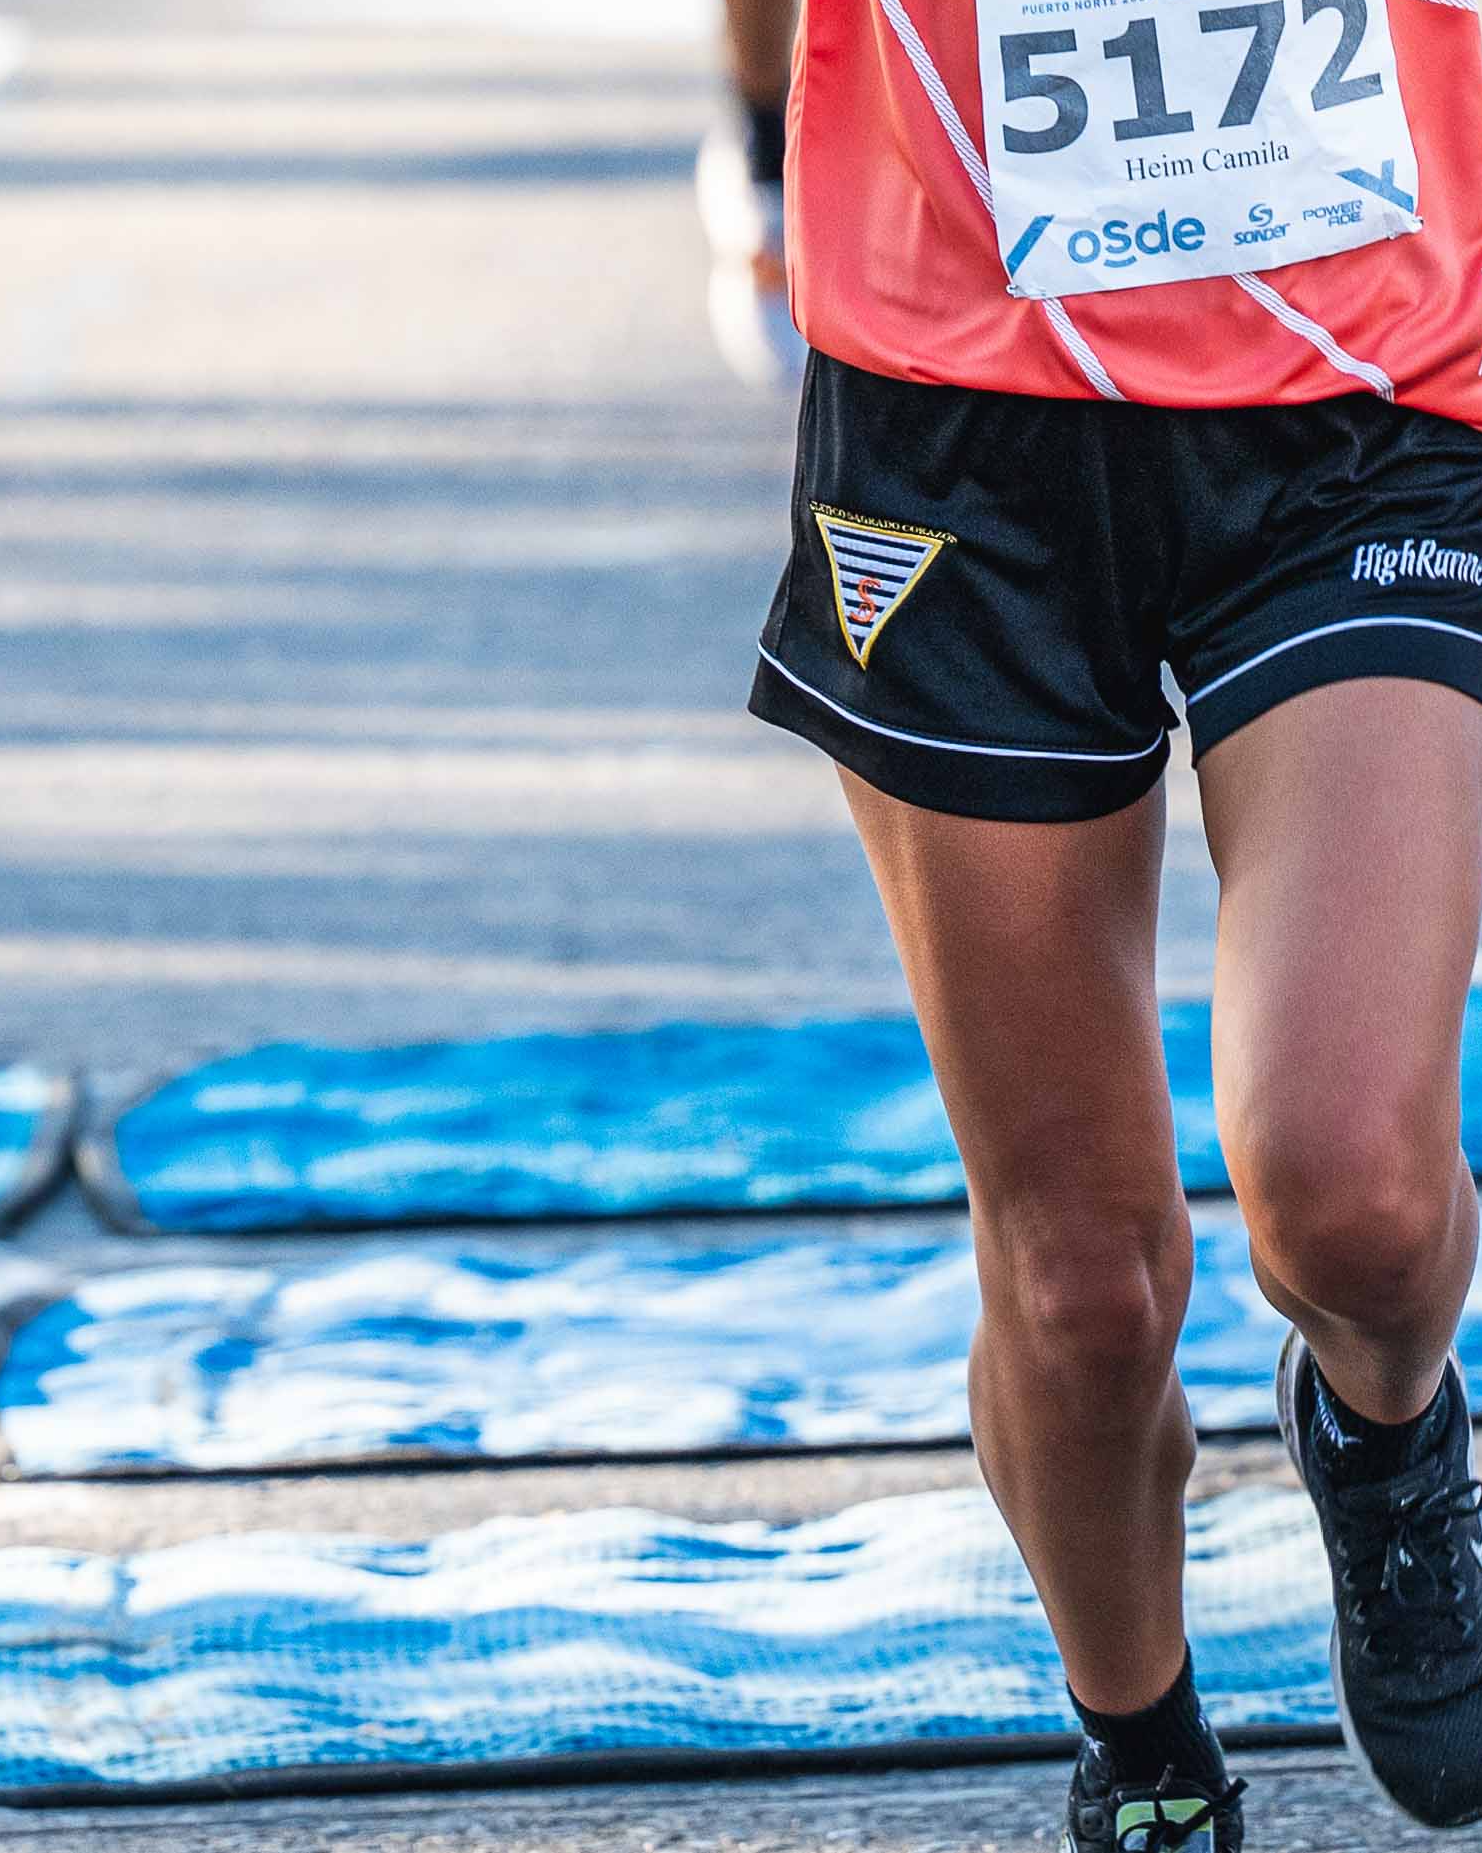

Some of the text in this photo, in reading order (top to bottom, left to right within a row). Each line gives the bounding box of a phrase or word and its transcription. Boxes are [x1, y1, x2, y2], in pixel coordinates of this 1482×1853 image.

[1022, 1, 1070, 15] PUERTO
[1125, 140, 1290, 181] Heim Camila
[1302, 200, 1364, 221] POWER
[1068, 208, 1206, 266] osde
